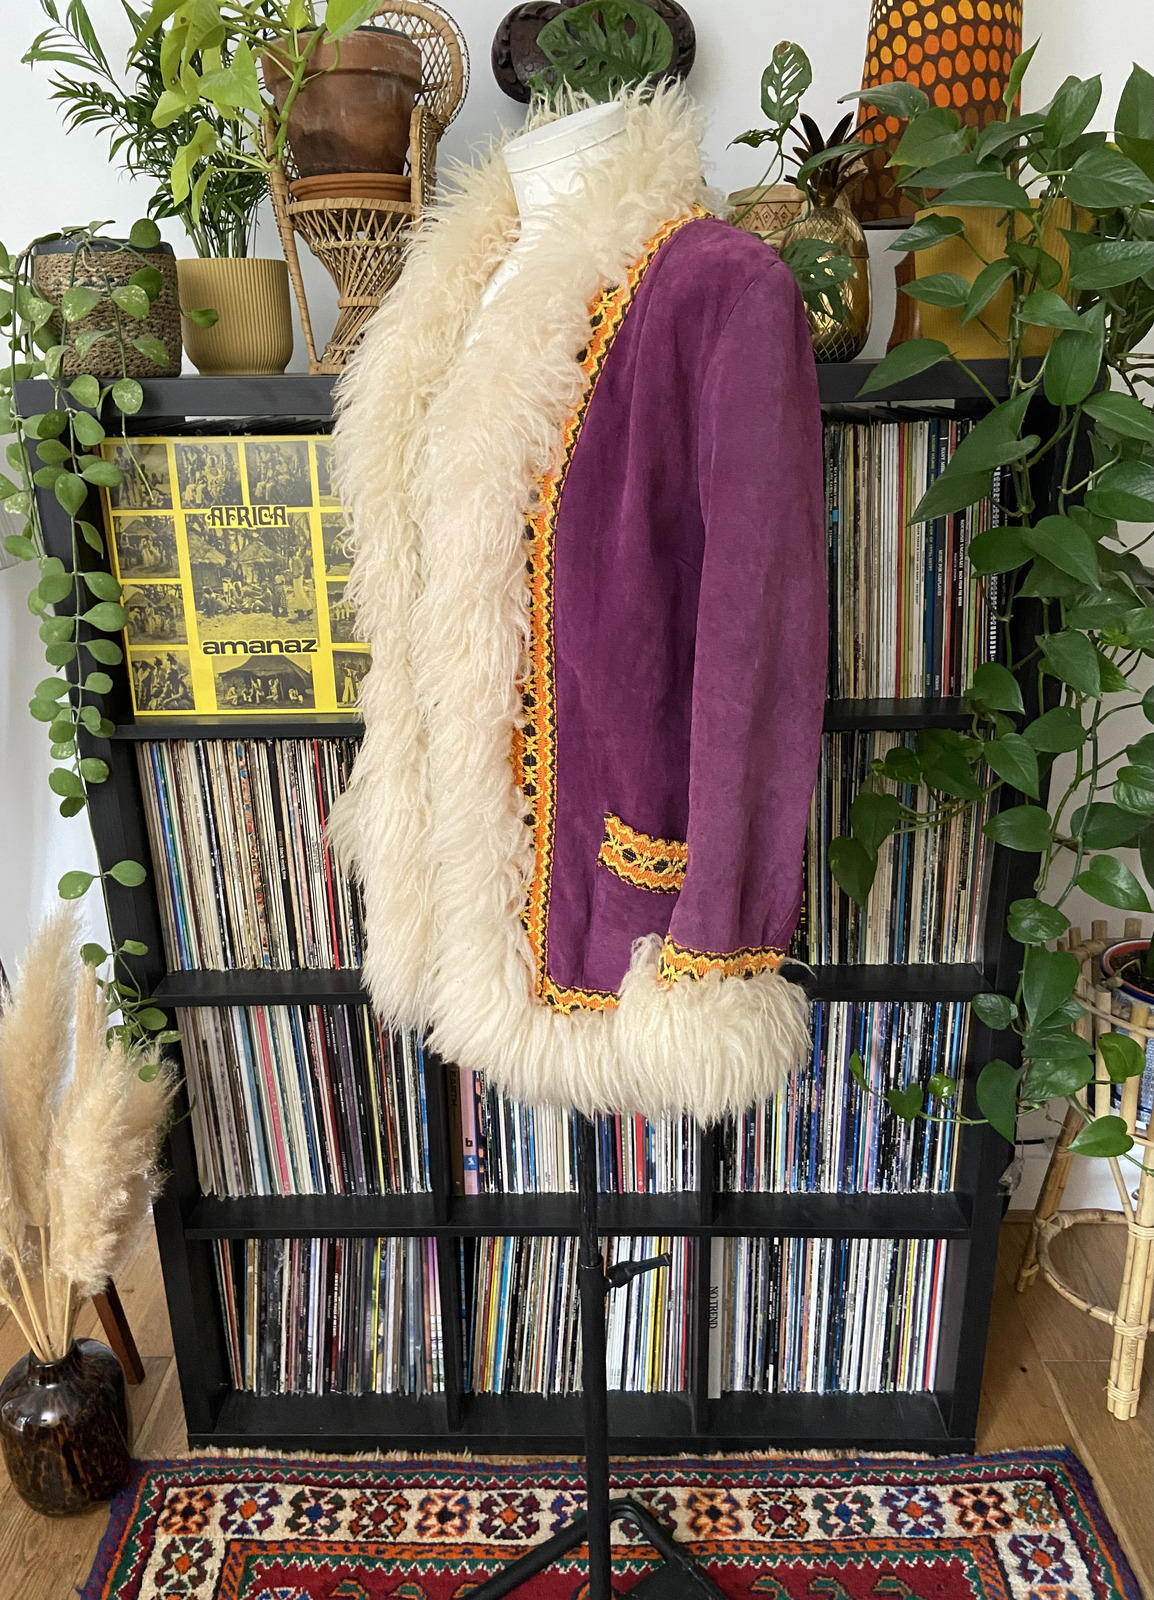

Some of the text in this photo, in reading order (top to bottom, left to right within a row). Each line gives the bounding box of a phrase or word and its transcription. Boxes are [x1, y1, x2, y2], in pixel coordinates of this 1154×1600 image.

[207, 506, 287, 528] AFRICA
[203, 639, 318, 655] amanaz
[708, 1286, 719, 1329] NO TREND
